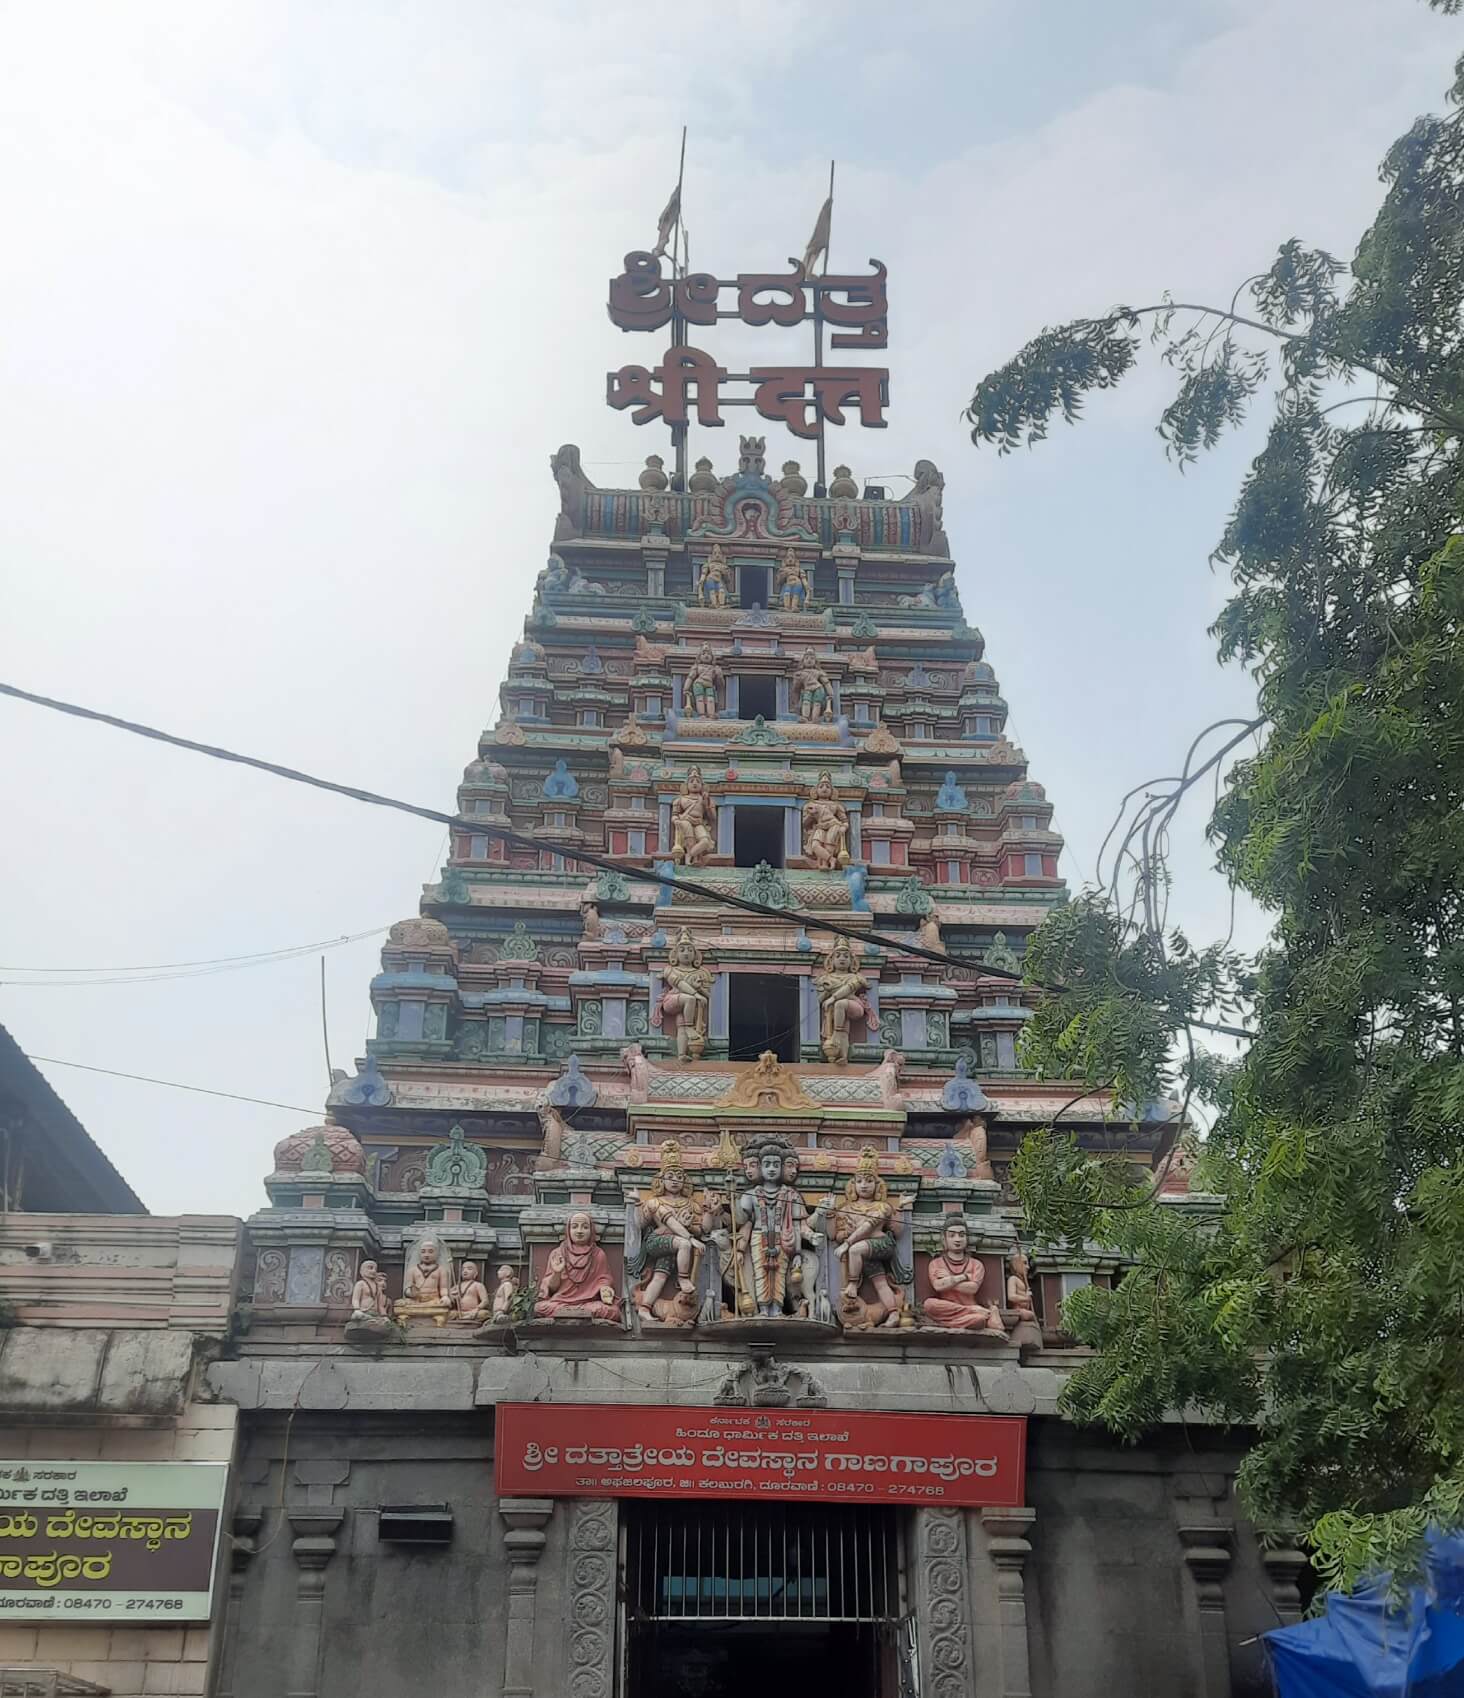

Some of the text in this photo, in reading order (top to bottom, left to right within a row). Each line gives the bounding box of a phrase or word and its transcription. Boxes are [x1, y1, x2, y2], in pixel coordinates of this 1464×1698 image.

[607, 250, 718, 332] ಶ್ರೀ
[606, 346, 728, 427] श्री
[522, 1442, 998, 1481] ಶ್ರೀ ದತ್ತಾತ್ರೇಯ ದೇವಸ್ಥಾನ ಗಾಣಗಾಪೂರ
[827, 1483, 875, 1493] 08470
[887, 1485, 945, 1496] 274768
[45, 1509, 193, 1552] ದೇವಸ್ಥಾನ
[63, 1598, 112, 1609] 08470
[126, 1599, 184, 1610] 274768
